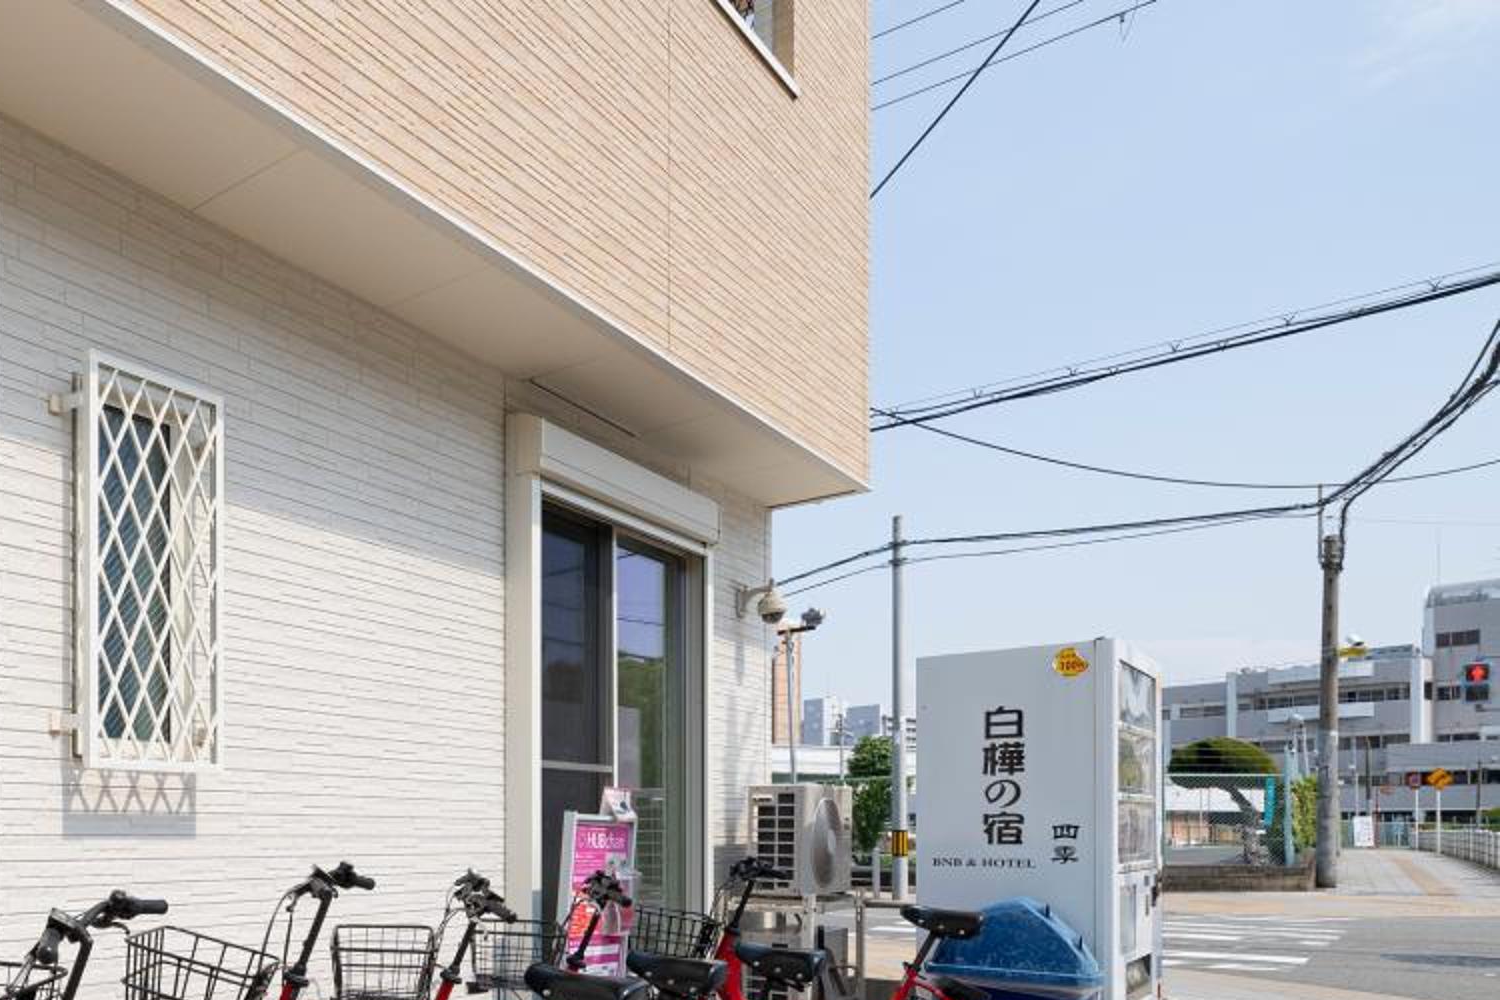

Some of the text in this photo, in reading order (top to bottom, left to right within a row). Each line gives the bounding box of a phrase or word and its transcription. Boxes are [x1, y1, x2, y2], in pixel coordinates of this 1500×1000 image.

[982, 706, 1026, 845] 白樺の宿
[932, 857, 962, 867] BNB
[982, 858, 1037, 869] HOTEL
[1050, 824, 1080, 864] 四季
